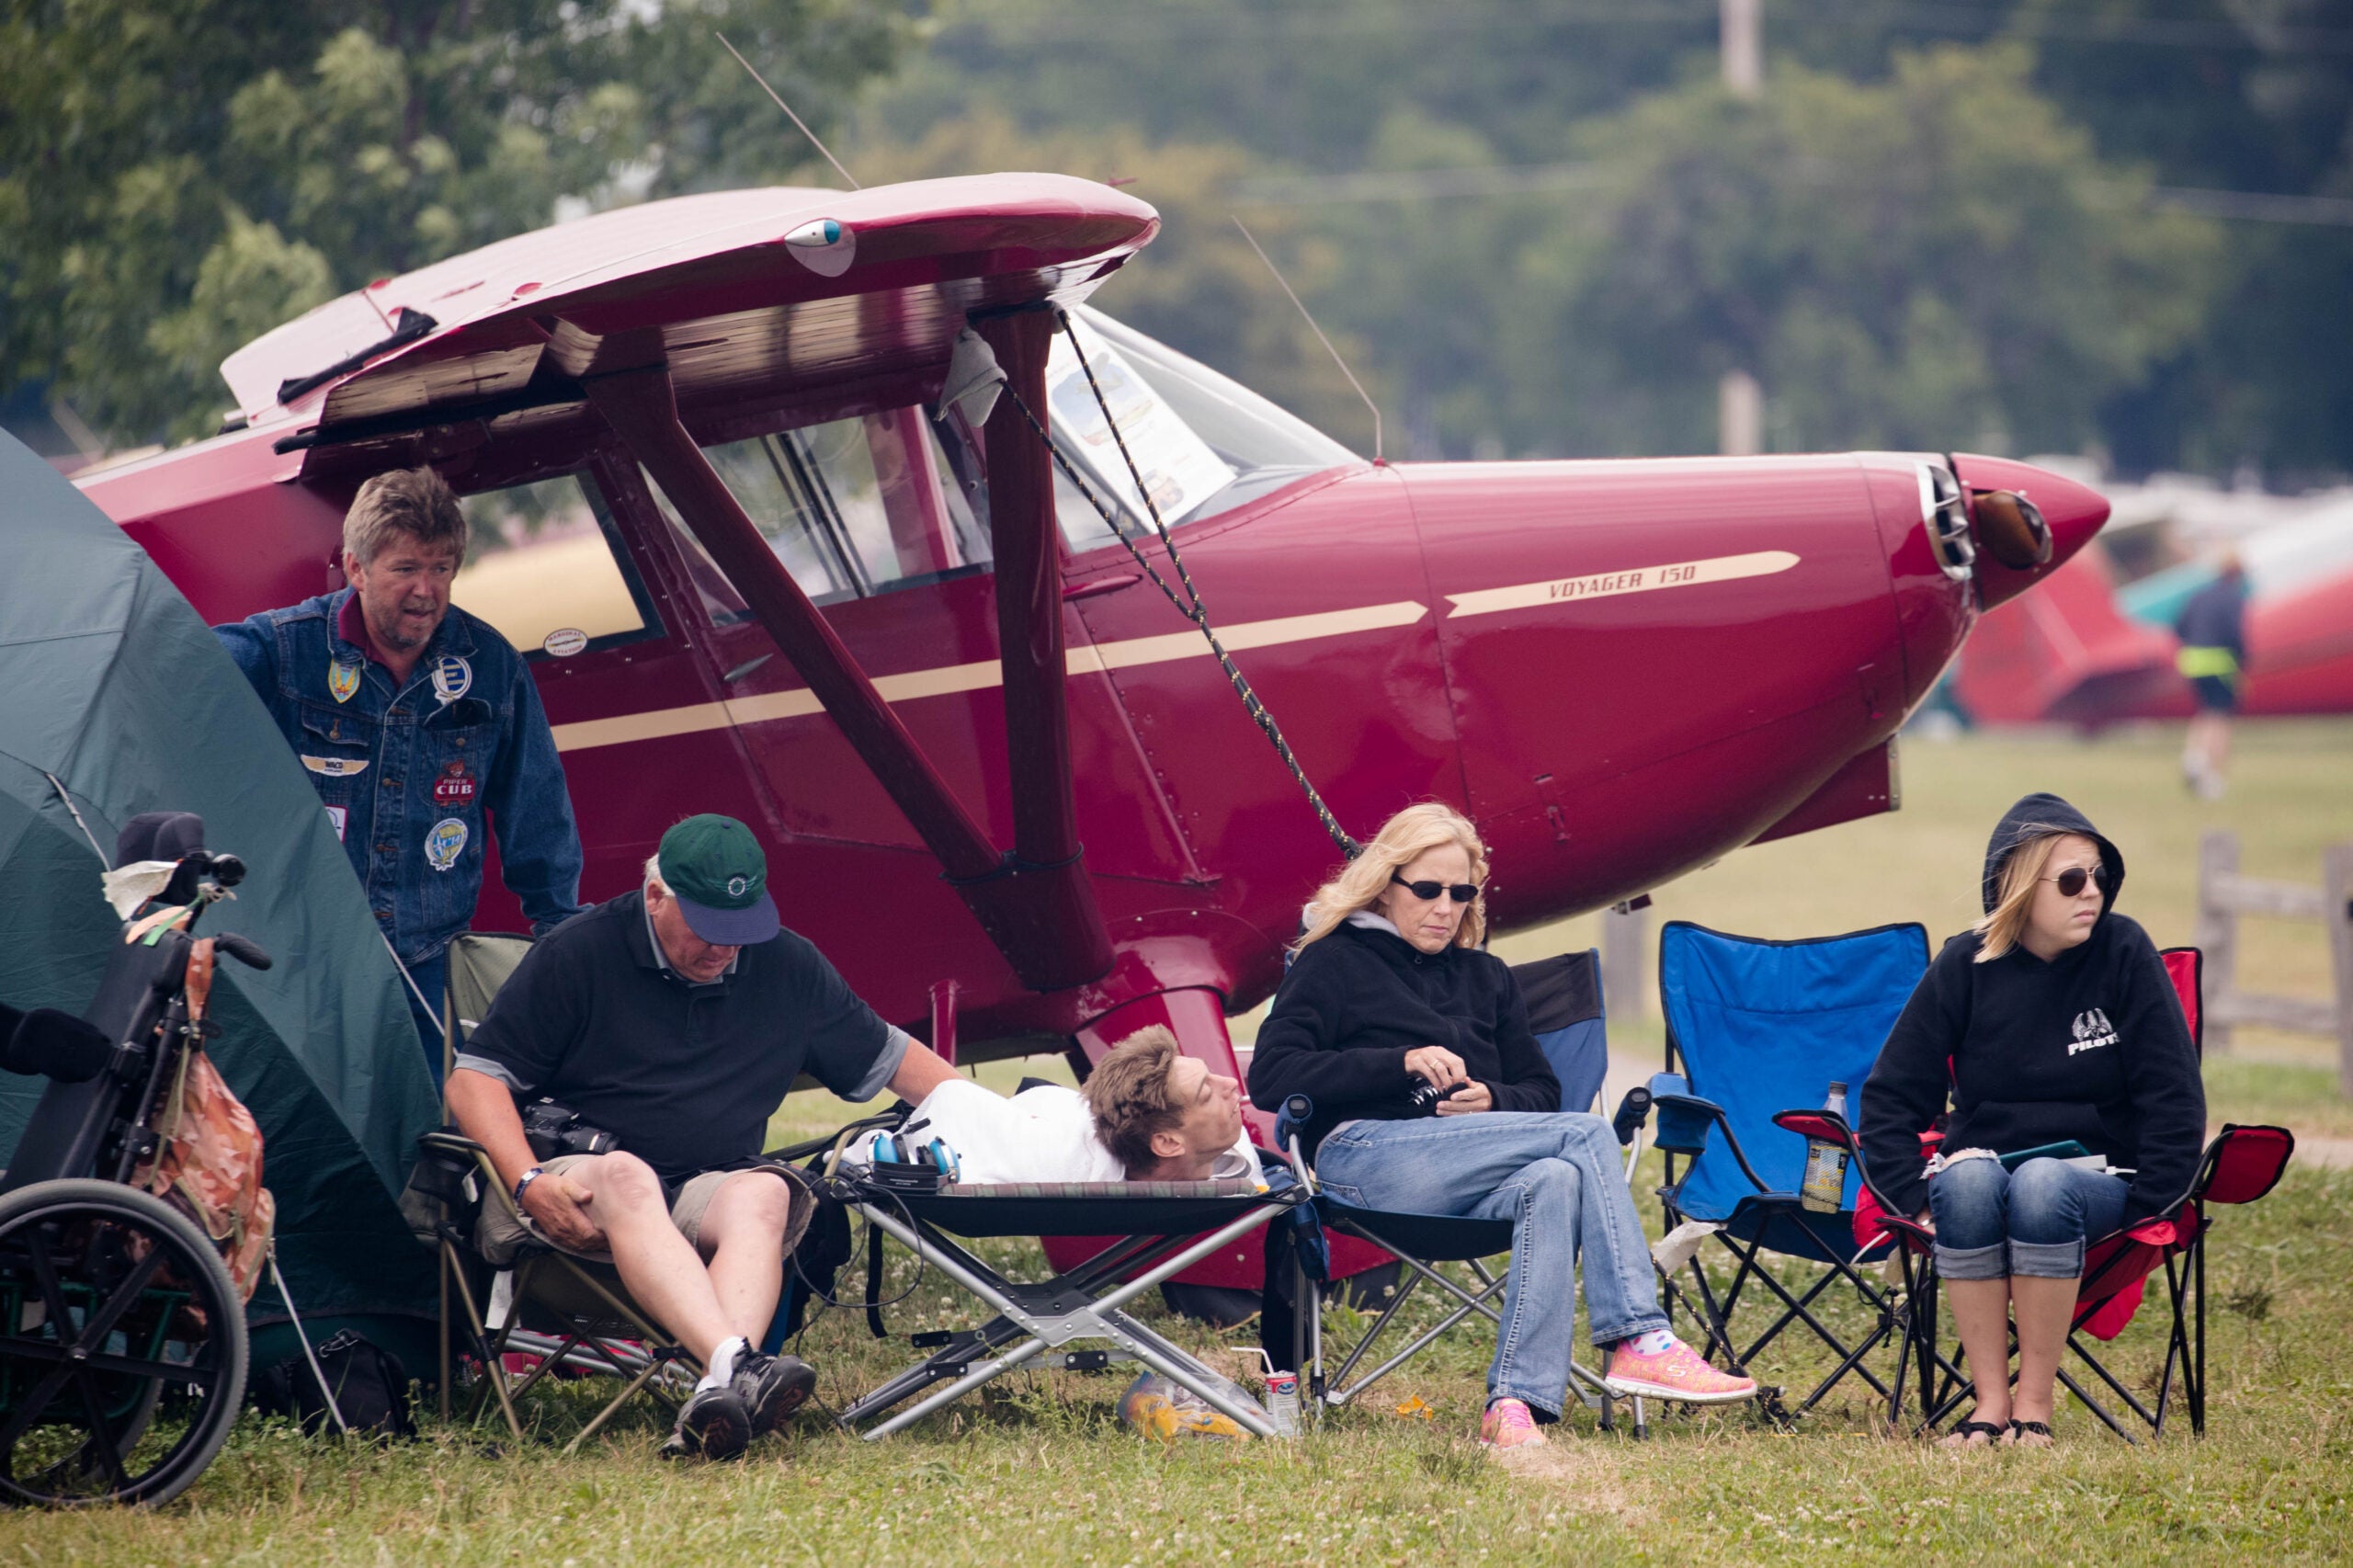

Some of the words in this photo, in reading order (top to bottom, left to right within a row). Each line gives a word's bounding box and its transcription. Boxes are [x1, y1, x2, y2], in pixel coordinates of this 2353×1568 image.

[1549, 572, 1643, 599] VOYAGER
[1659, 564, 1697, 585] 150
[547, 631, 582, 642] MARGINAL
[552, 644, 584, 654] AVIATION
[437, 784, 472, 795] CUB
